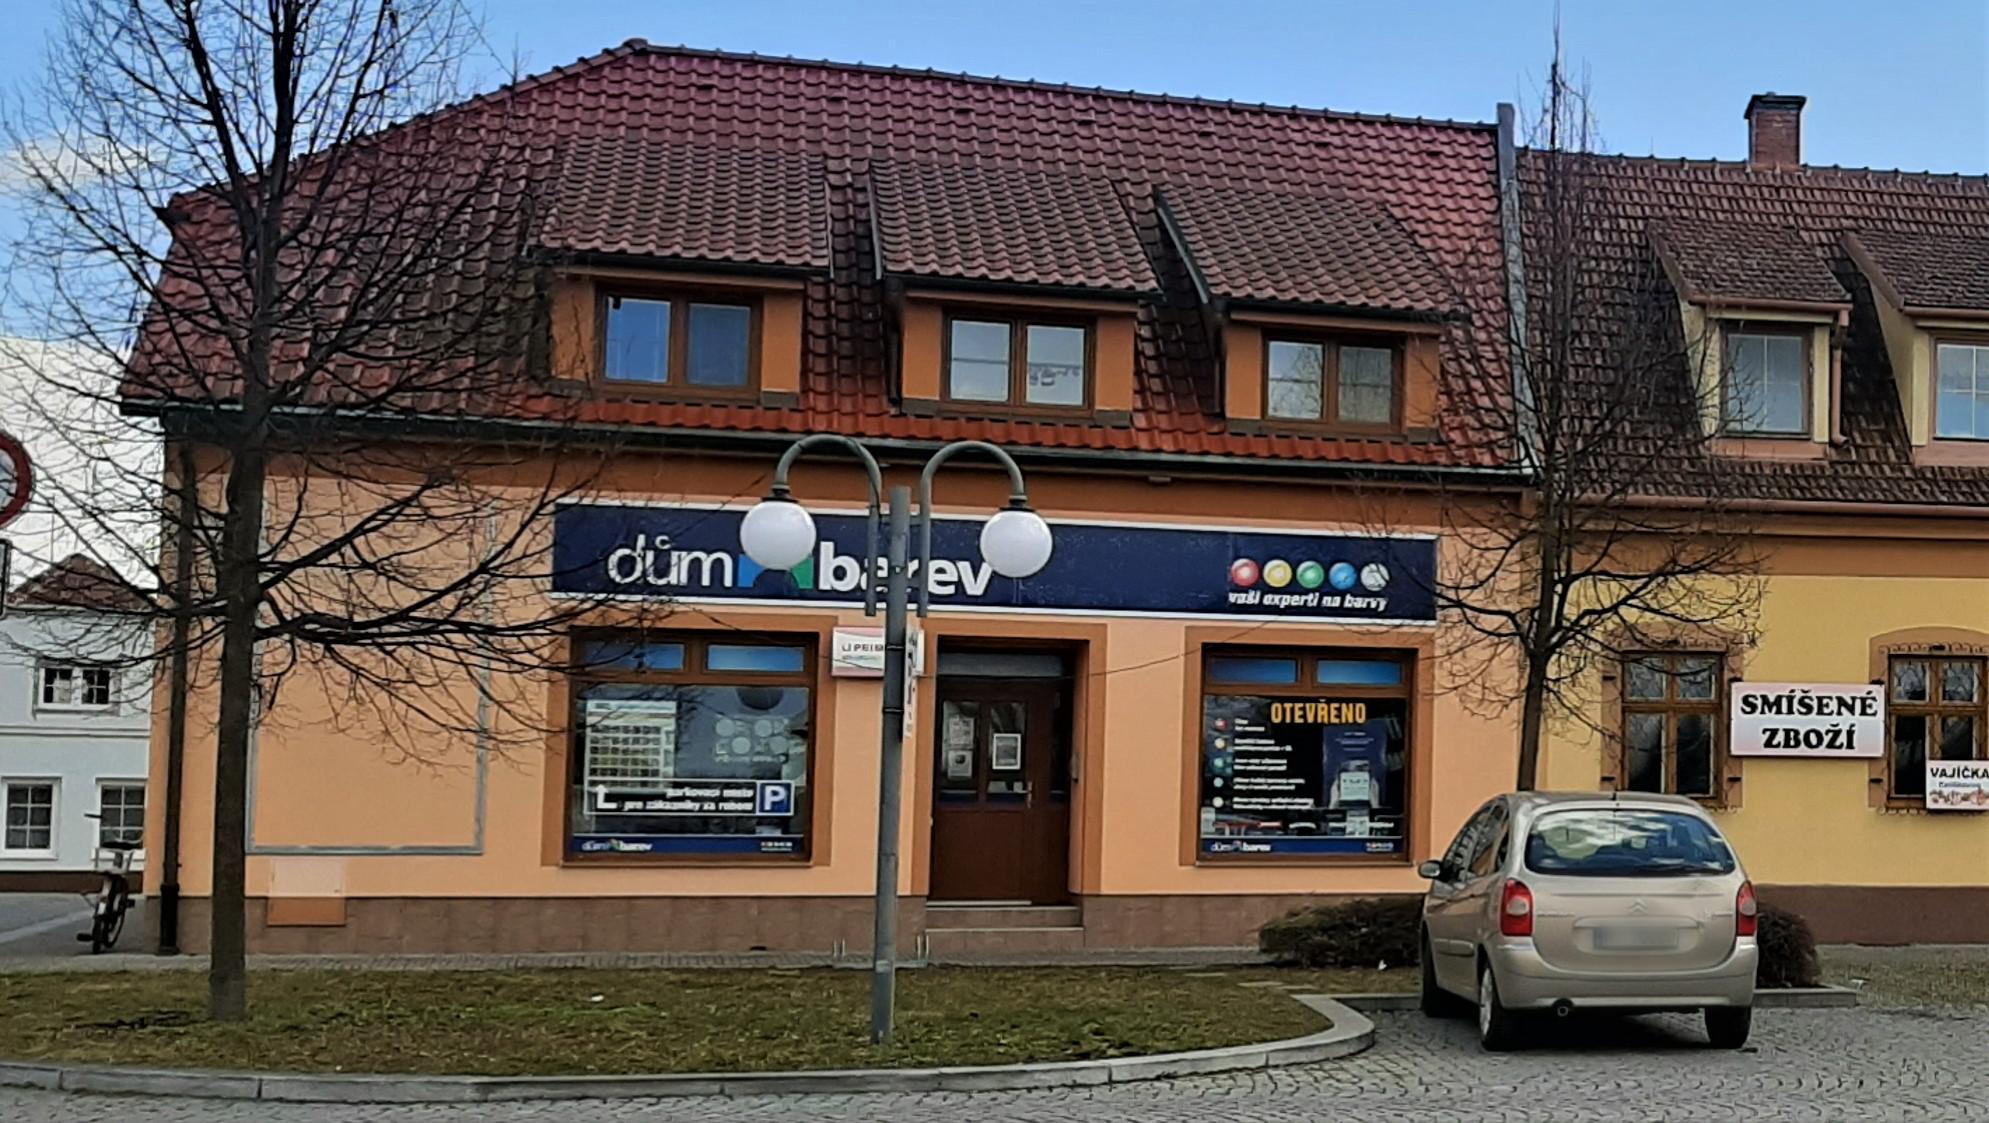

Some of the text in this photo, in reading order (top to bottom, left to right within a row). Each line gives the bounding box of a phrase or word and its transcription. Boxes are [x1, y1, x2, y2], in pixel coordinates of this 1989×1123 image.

[607, 534, 734, 588] dům
[1263, 592, 1319, 609] experti
[1321, 596, 1341, 608] na
[1343, 594, 1388, 612] barvy
[1270, 699, 1366, 724] OTEVŘENO
[1740, 689, 1878, 716] SMÍŠENÉ
[1761, 723, 1856, 750] ZBOŽÍ
